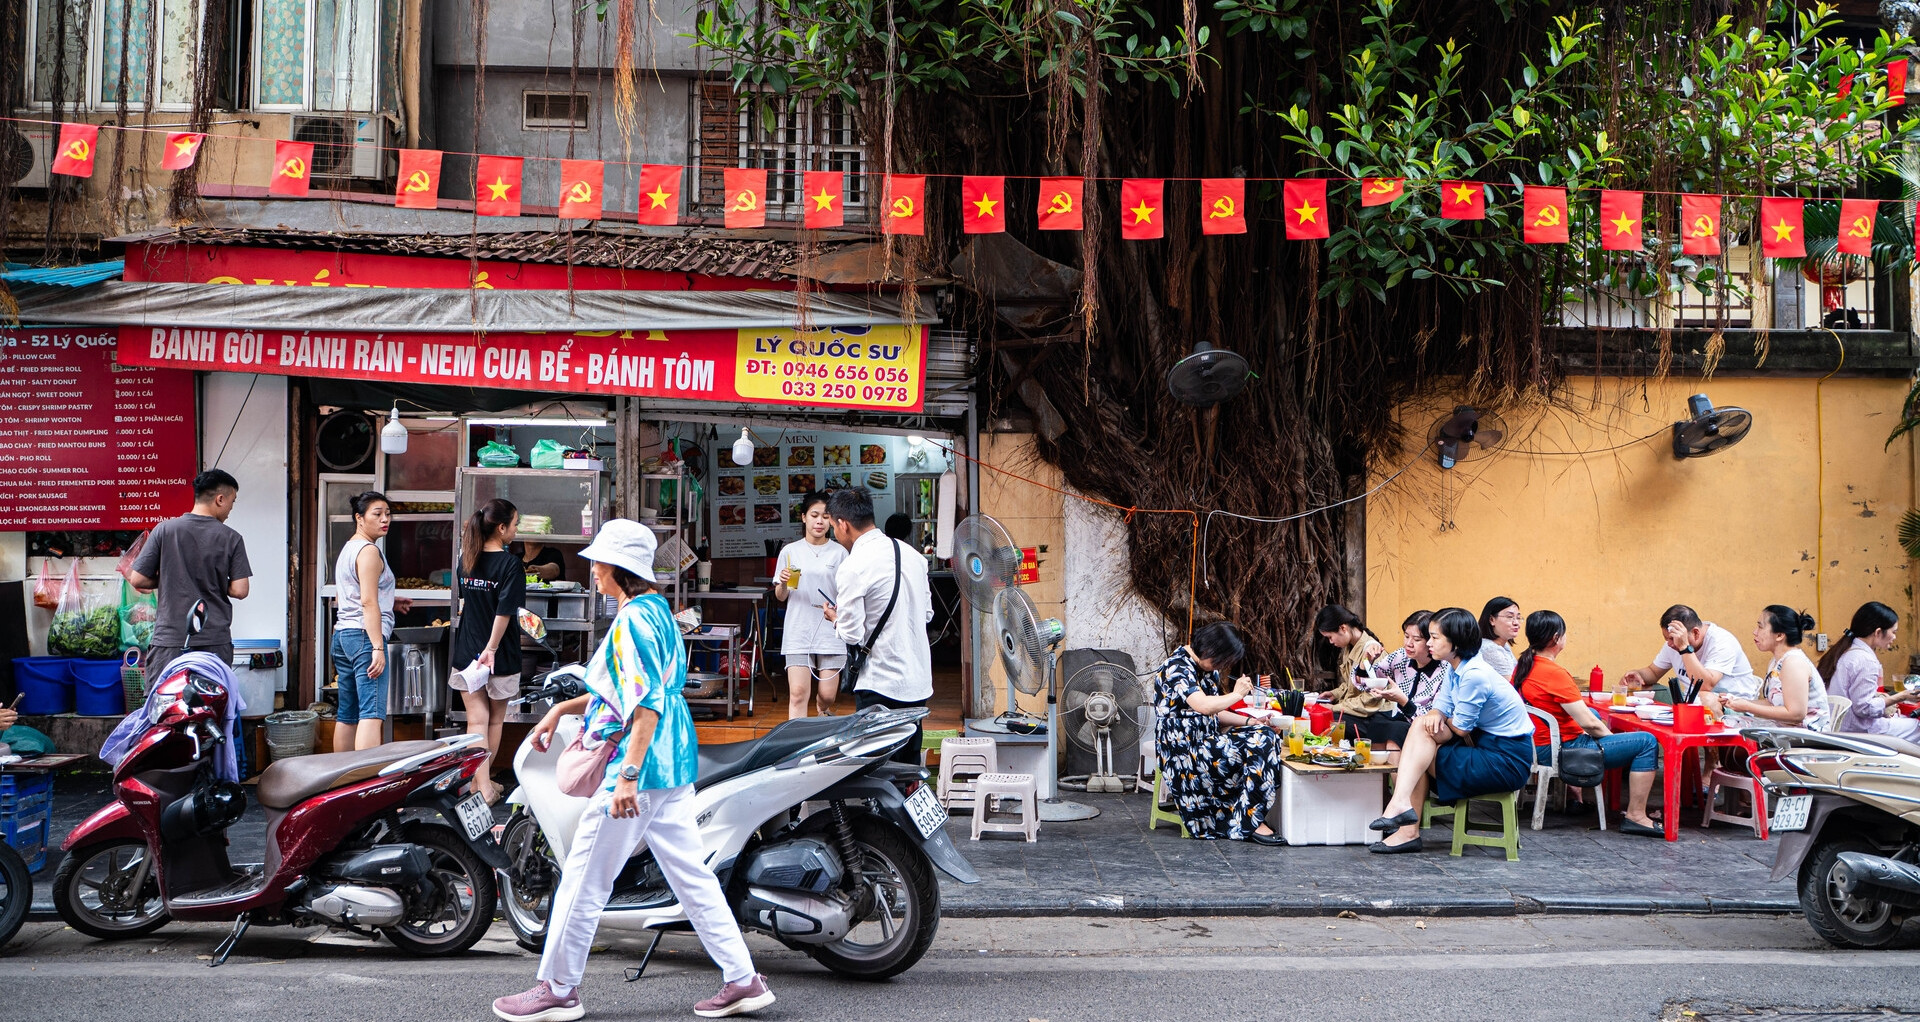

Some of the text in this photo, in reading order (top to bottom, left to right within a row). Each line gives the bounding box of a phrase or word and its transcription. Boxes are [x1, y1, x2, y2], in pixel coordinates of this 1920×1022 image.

[31, 335, 49, 347] 52
[53, 333, 72, 349] Lý
[75, 332, 117, 348] Quốc
[755, 335, 902, 360] LÝ QUỐC SƯ
[279, 330, 347, 370] BÁNH
[353, 334, 404, 374] RÁN
[420, 343, 476, 377] NEM
[483, 347, 532, 381] CUA
[539, 338, 571, 383] BỂ
[587, 347, 655, 389] BÁNH
[662, 351, 716, 392] TÔM
[746, 359, 909, 383] ĐT: 0946 656 056
[782, 380, 908, 403] 033 250 0978
[785, 435, 818, 444] MENU
[144, 465, 156, 473] CÁI
[358, 778, 412, 798] VISION
[909, 788, 930, 816] 29-F1
[1780, 797, 1806, 812] 29-C1
[918, 803, 946, 834] 599.99
[1774, 812, 1805, 828] 929.79
